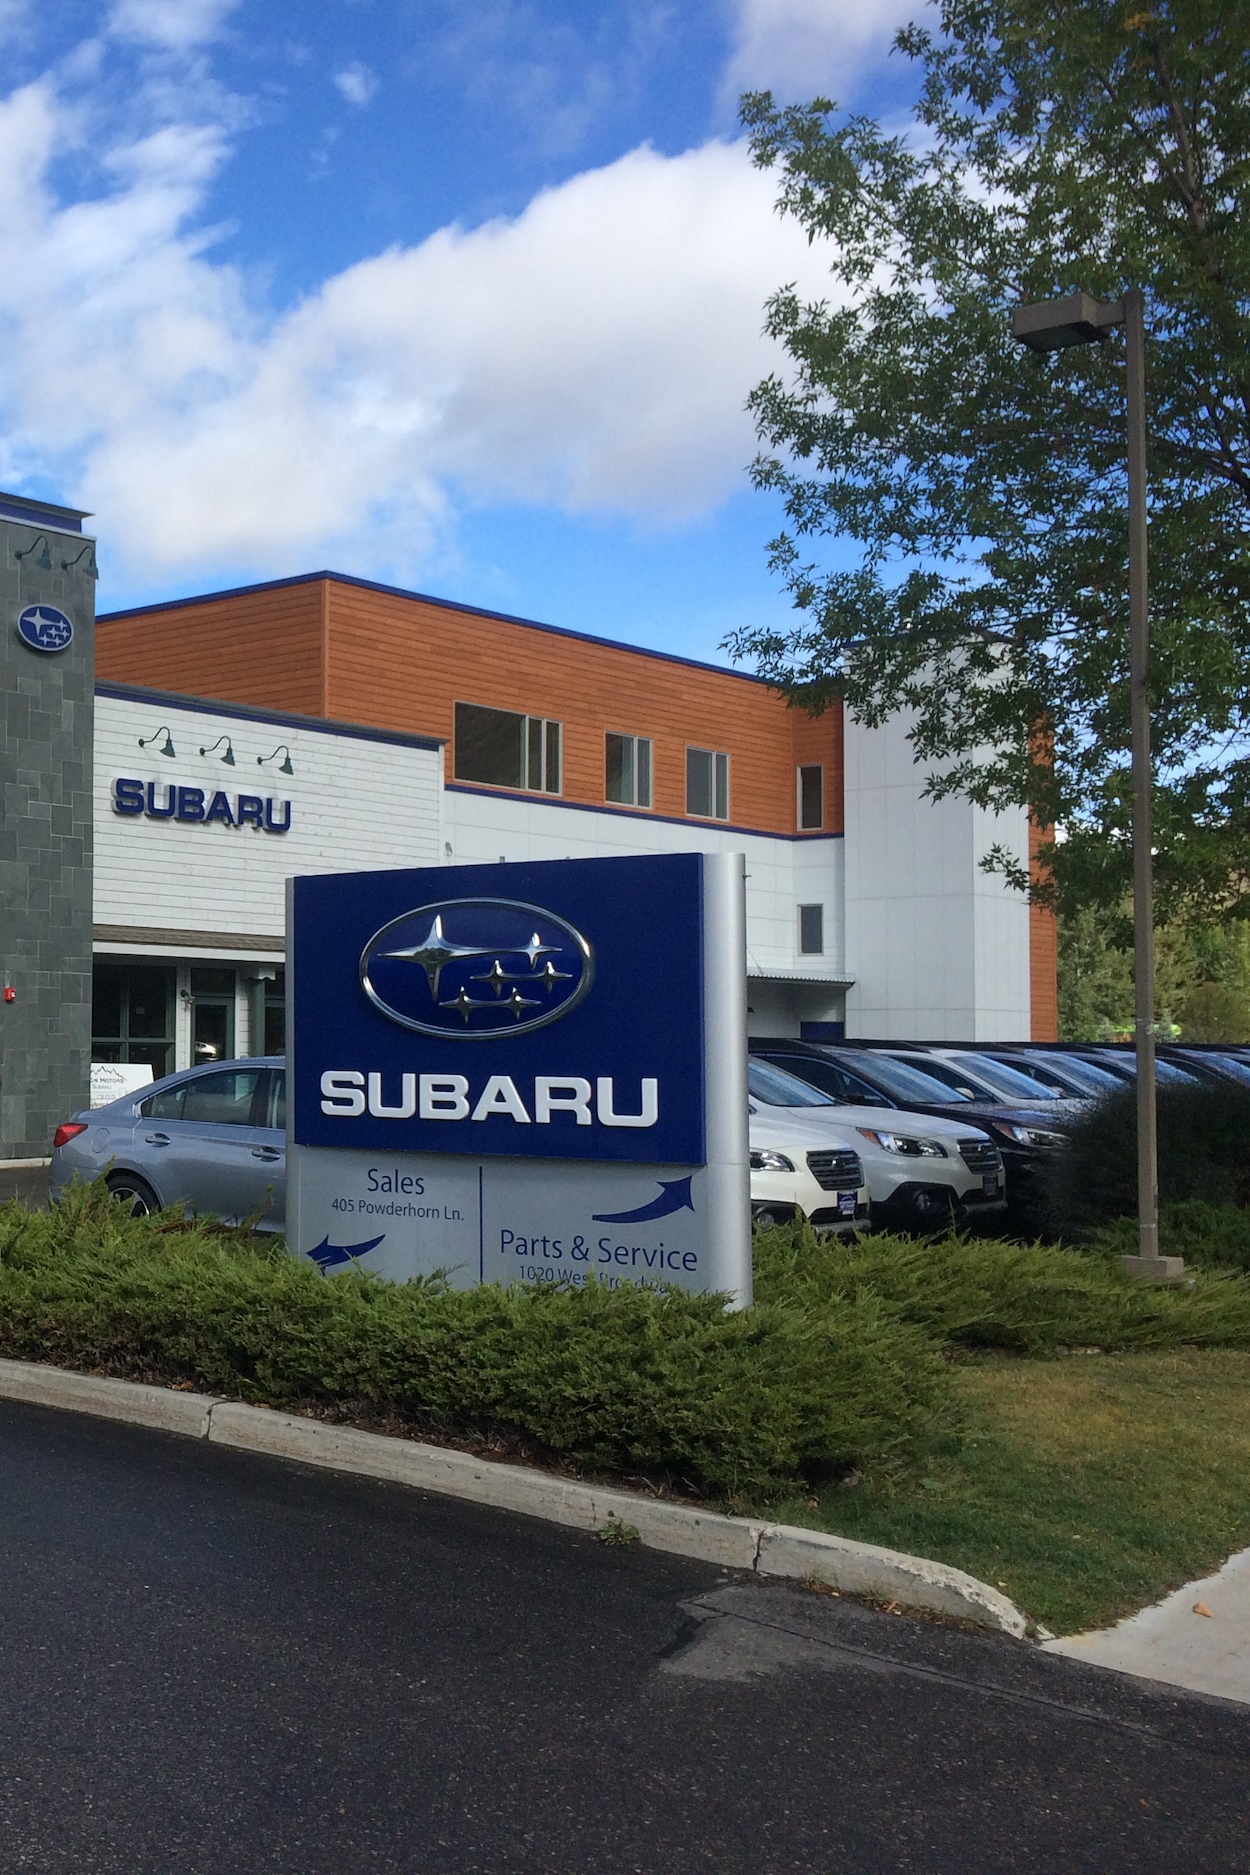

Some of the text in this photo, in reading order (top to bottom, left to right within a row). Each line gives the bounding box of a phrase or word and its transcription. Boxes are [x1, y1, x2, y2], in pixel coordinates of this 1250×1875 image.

[112, 777, 291, 832] SUBARU
[320, 1070, 659, 1128] SUBARU
[367, 1168, 425, 1195] Sales
[331, 1198, 465, 1221] 405 Powderhorn Ln.
[500, 1229, 697, 1271] Parts & Service
[520, 1265, 554, 1282] 1020
[558, 1269, 588, 1286] Wes
